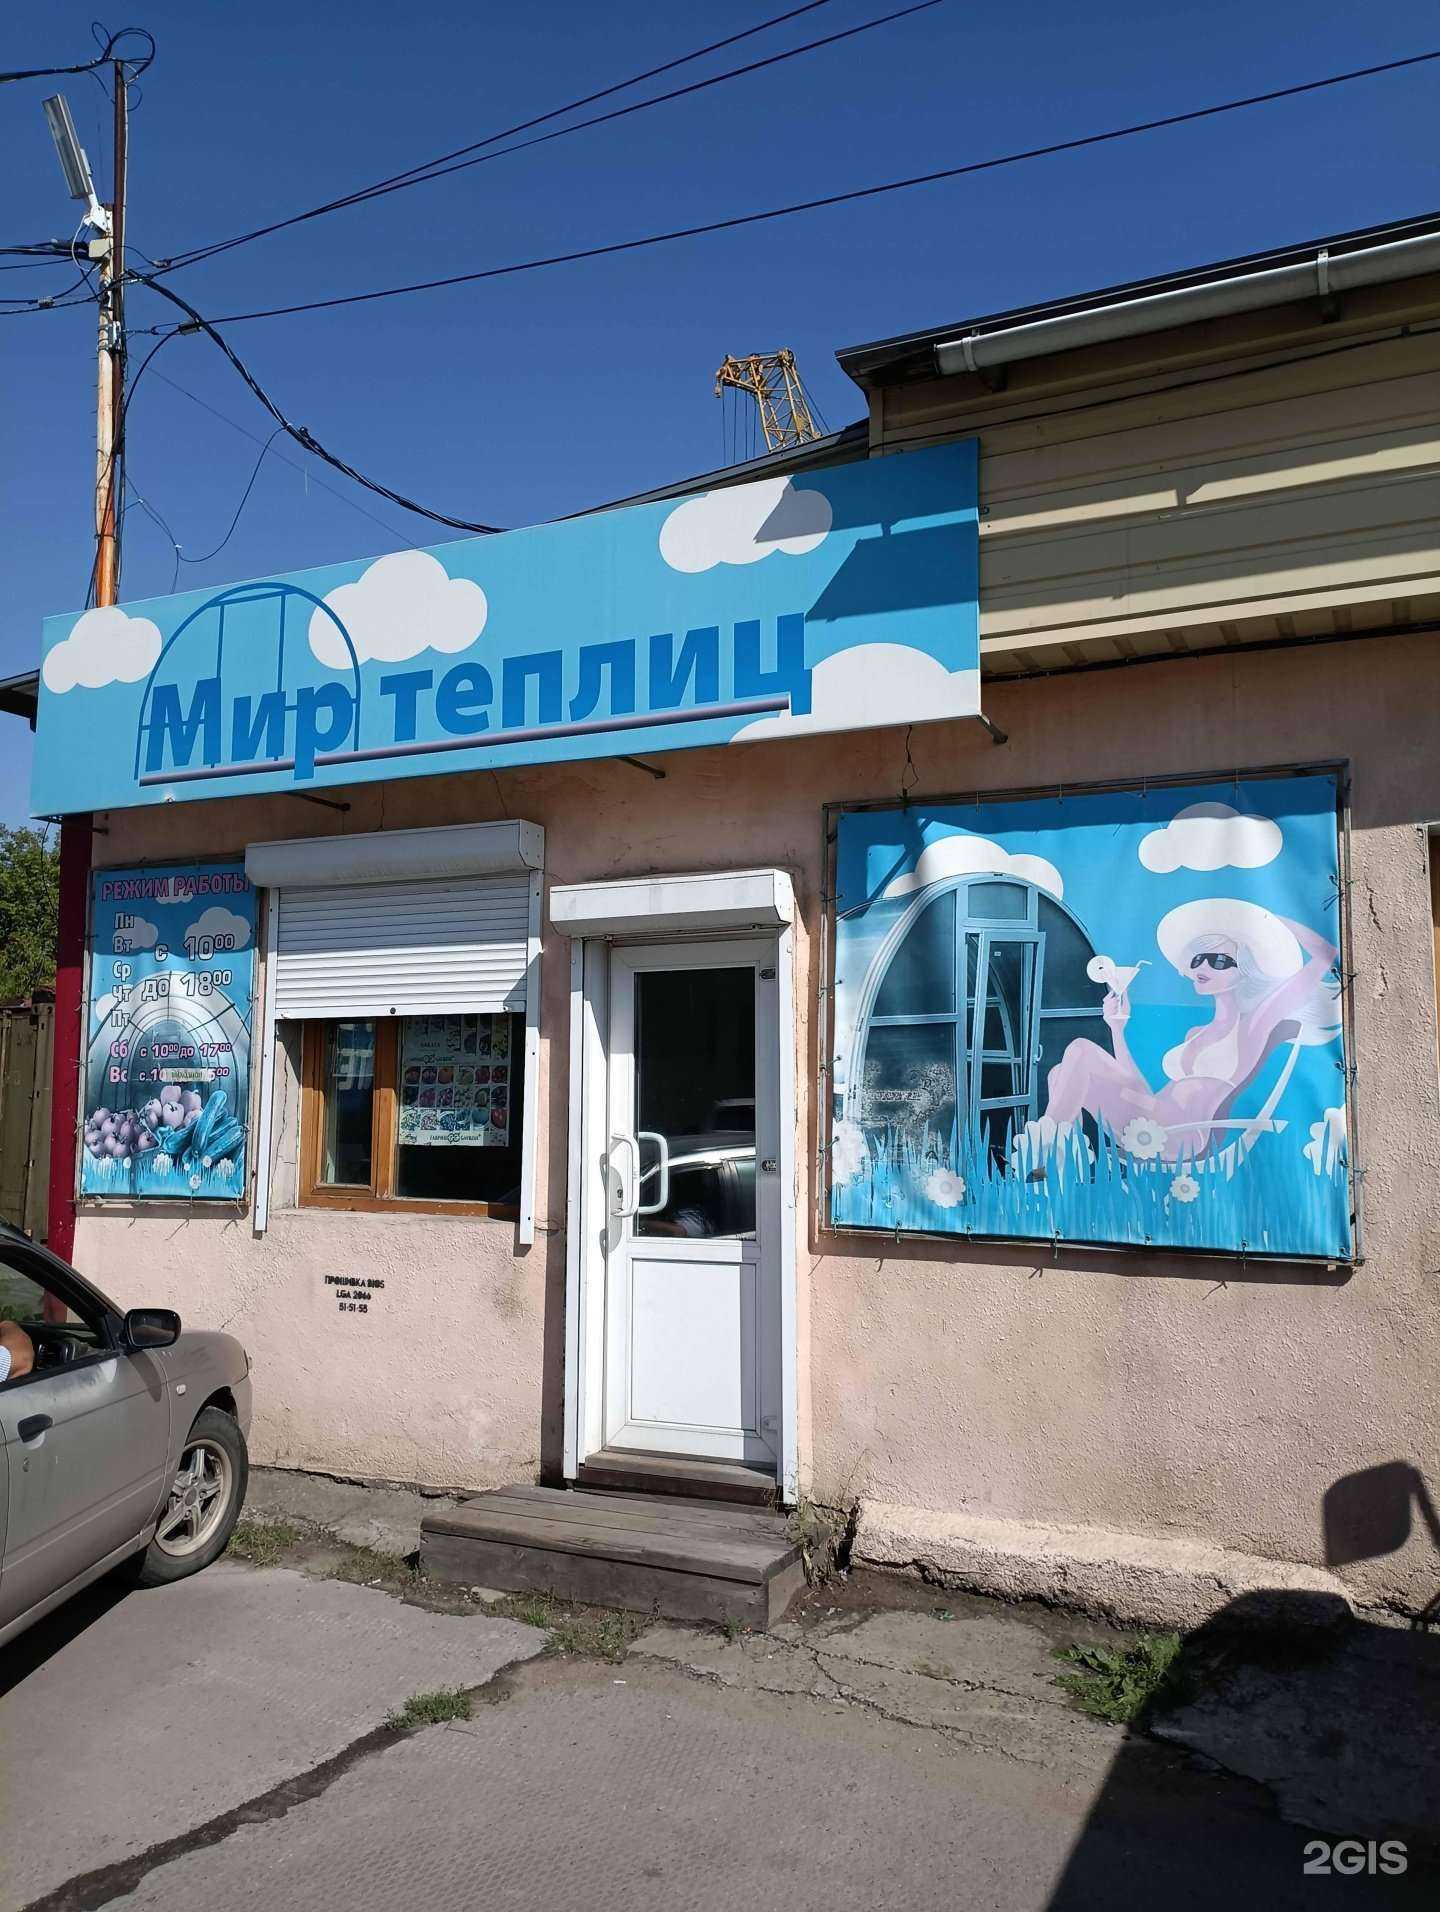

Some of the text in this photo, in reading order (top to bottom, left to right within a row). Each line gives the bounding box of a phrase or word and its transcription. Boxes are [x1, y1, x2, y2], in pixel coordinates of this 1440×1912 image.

[146, 612, 812, 780] Мир теплиц
[101, 873, 249, 901] РЕЖИМ РАБОТЫ
[114, 912, 134, 929] Пн
[113, 936, 133, 953] Вт
[154, 944, 168, 962] с
[113, 960, 131, 982] Ср
[112, 985, 132, 1002] Чт
[141, 979, 170, 1001] до
[111, 1009, 130, 1027] Пт
[110, 1040, 128, 1058] Сб
[180, 1046, 194, 1059] до
[109, 1066, 128, 1083] Вс
[336, 1289, 351, 1299] LGA
